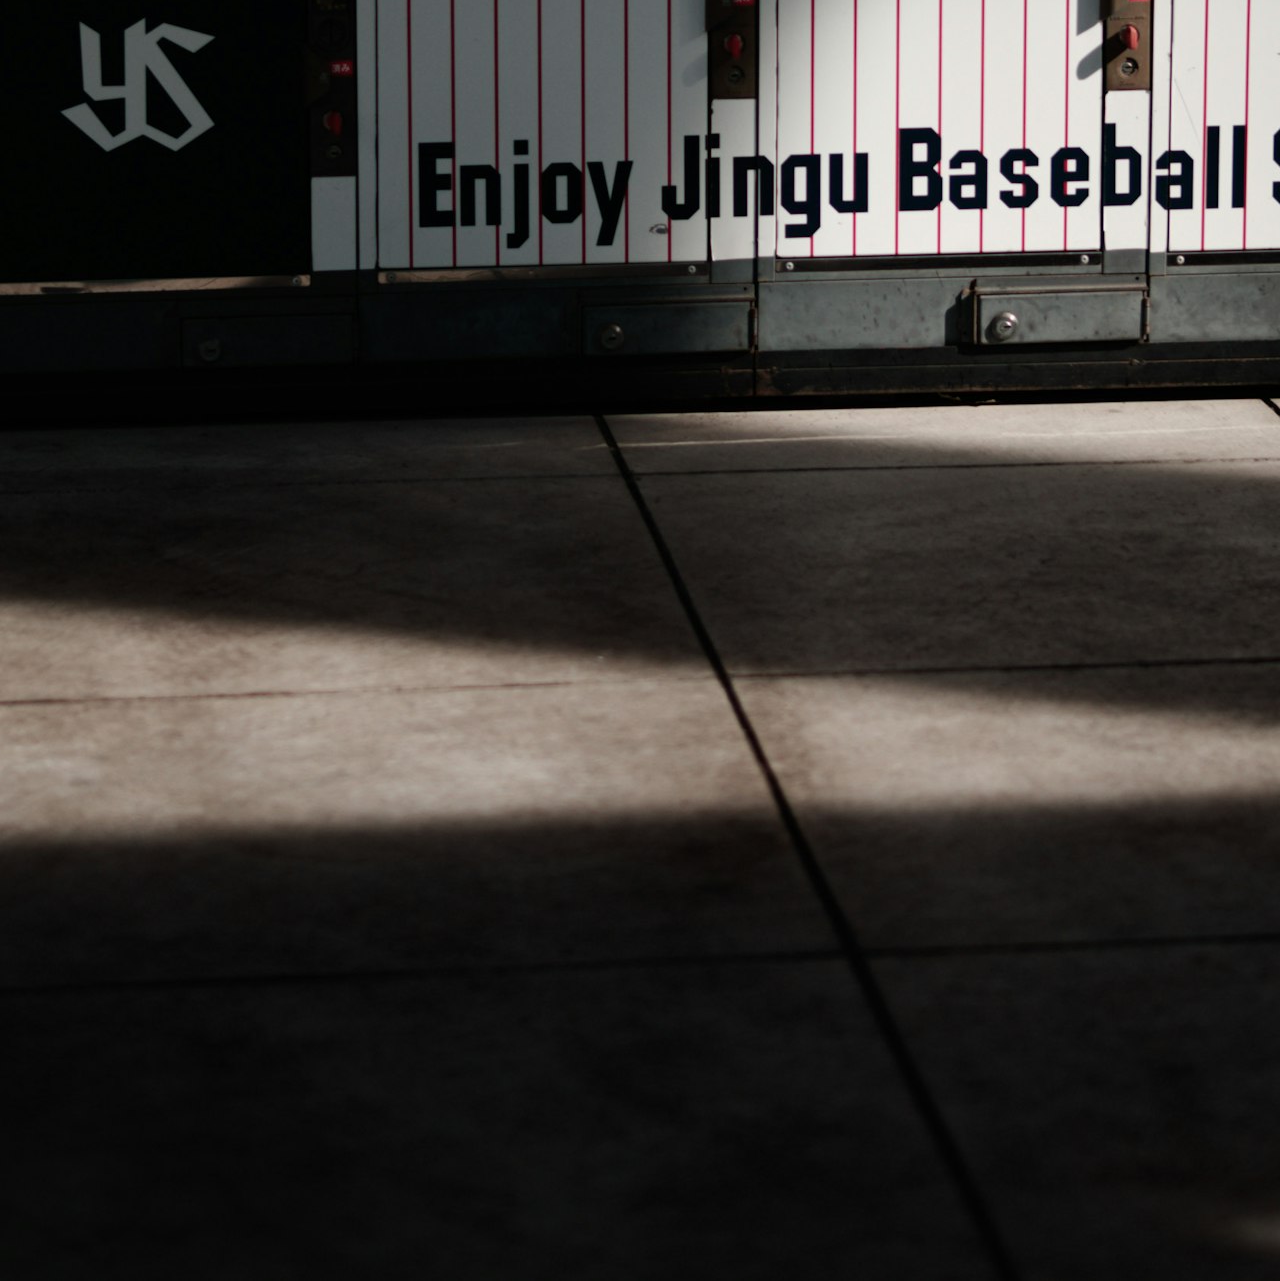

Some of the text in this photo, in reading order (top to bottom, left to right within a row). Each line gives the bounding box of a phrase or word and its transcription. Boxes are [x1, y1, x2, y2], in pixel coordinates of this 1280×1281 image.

[417, 140, 634, 248] Enjoy
[660, 134, 868, 238] Jingu
[897, 123, 1247, 211] Baseball
